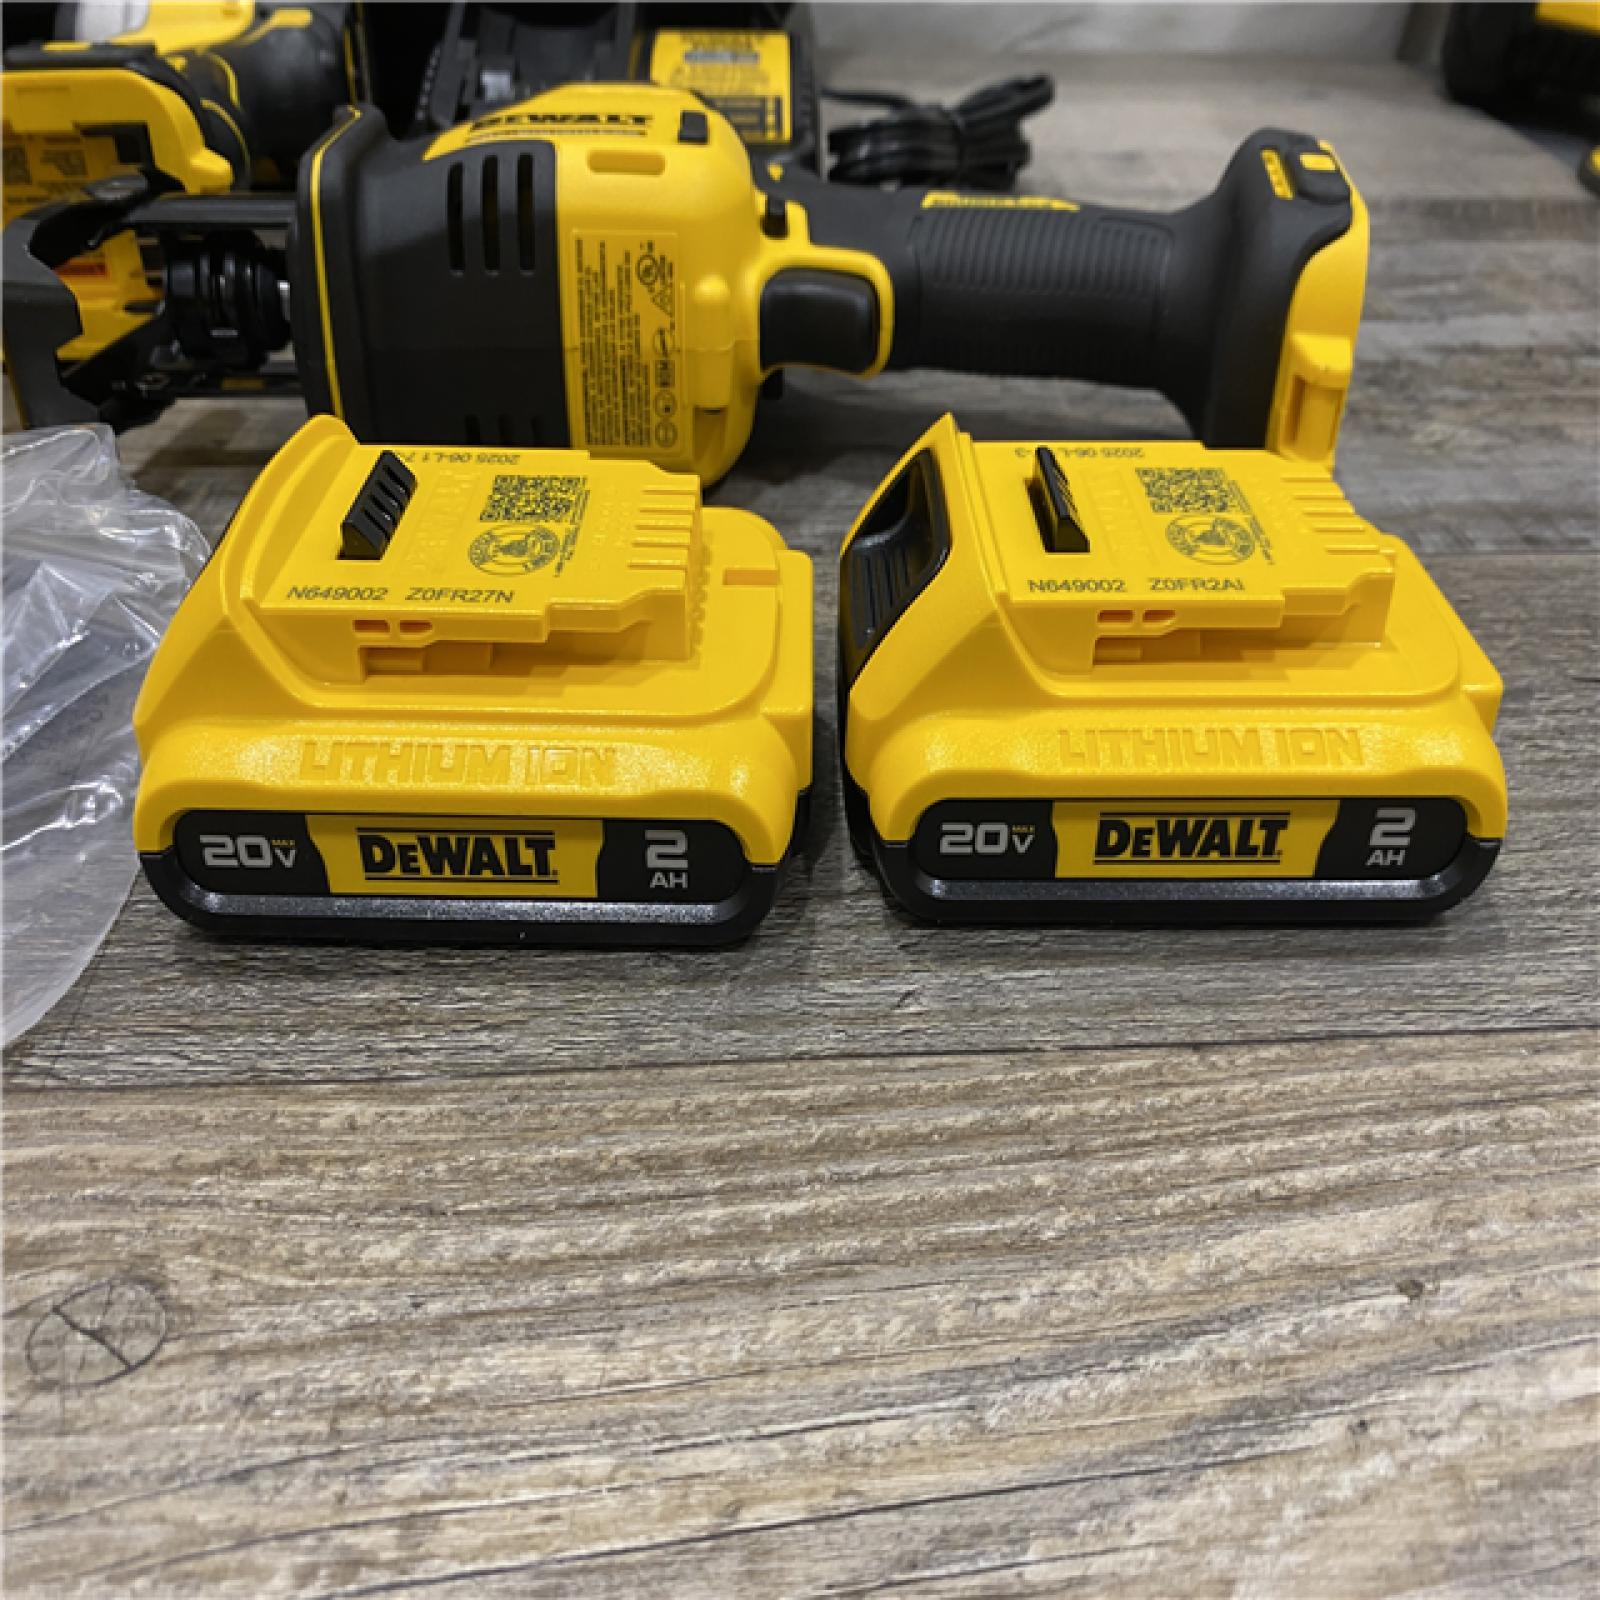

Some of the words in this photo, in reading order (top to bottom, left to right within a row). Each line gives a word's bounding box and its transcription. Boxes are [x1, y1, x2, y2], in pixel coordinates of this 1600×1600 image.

[286, 586, 389, 602] N649002
[1027, 579, 1128, 593] N649002
[1058, 728, 1263, 767] LITHIUM
[1272, 728, 1365, 768] ION
[300, 741, 511, 785] LITHIUM
[524, 747, 617, 787] ION
[1370, 807, 1416, 847] 2
[645, 830, 688, 868] 2
[1365, 849, 1406, 866] AH
[650, 871, 688, 889] AH
